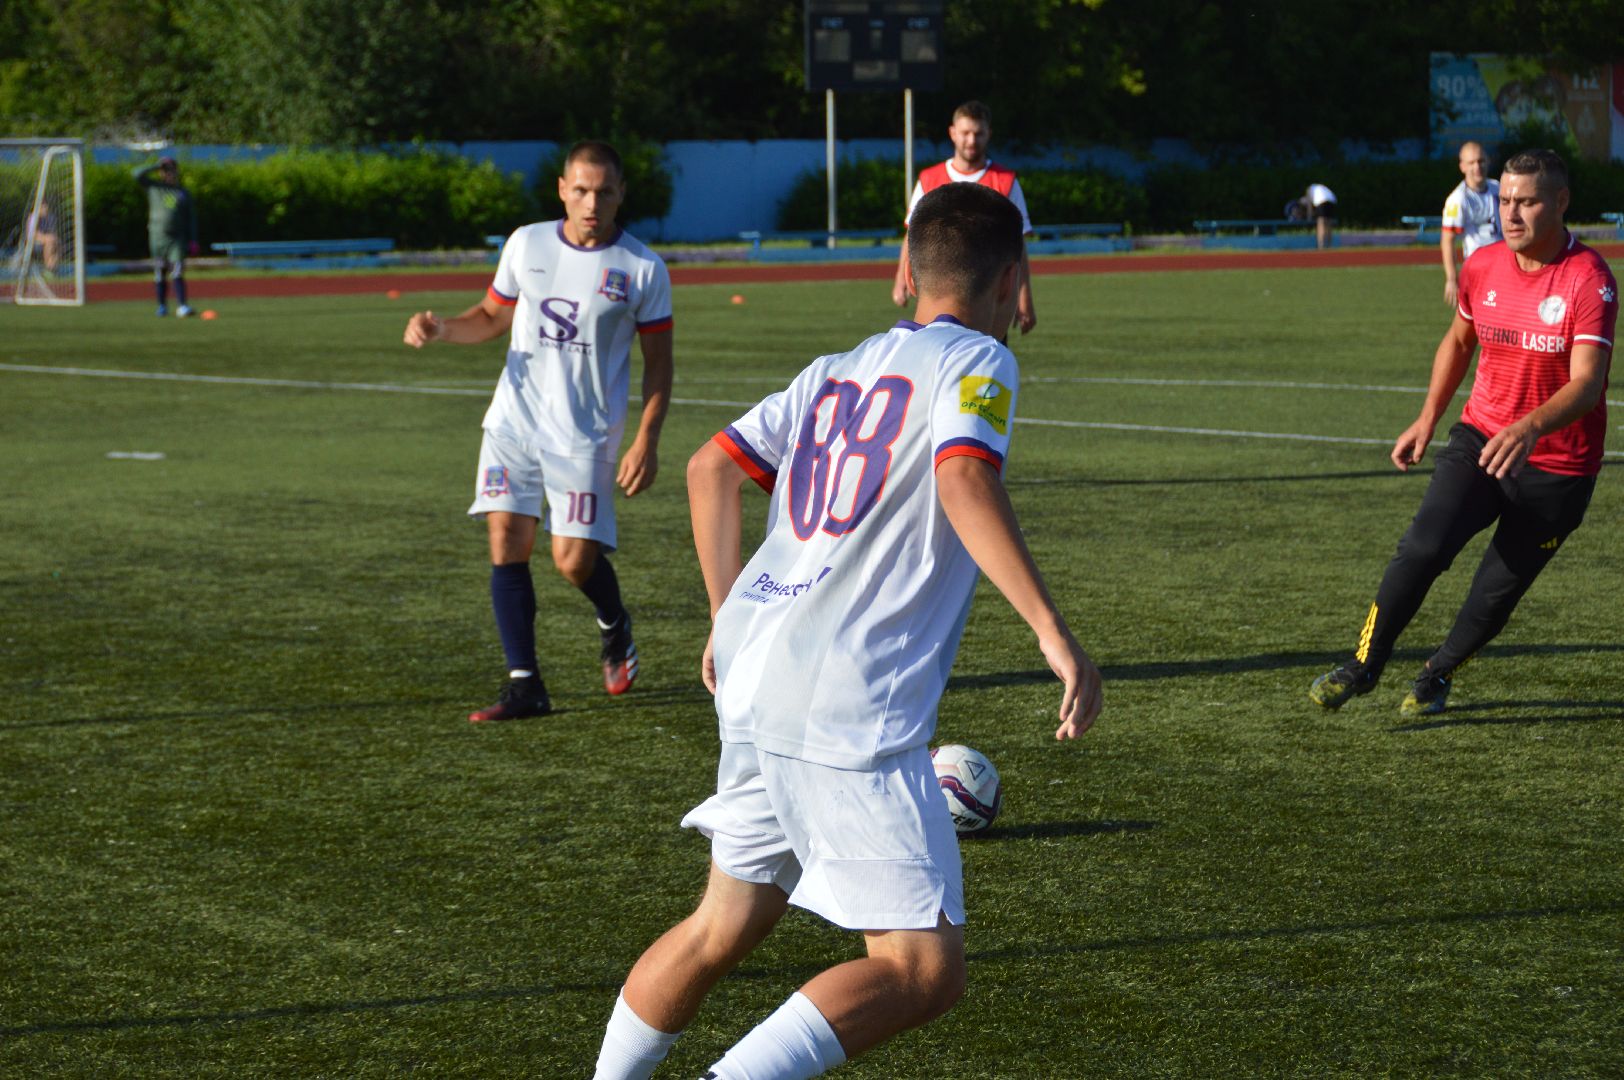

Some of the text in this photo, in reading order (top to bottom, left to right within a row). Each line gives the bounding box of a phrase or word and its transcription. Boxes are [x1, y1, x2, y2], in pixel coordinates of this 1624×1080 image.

[538, 297, 580, 342] S
[1476, 323, 1566, 353] TECHNO LASER
[788, 375, 914, 541] 88
[566, 491, 597, 525] 10
